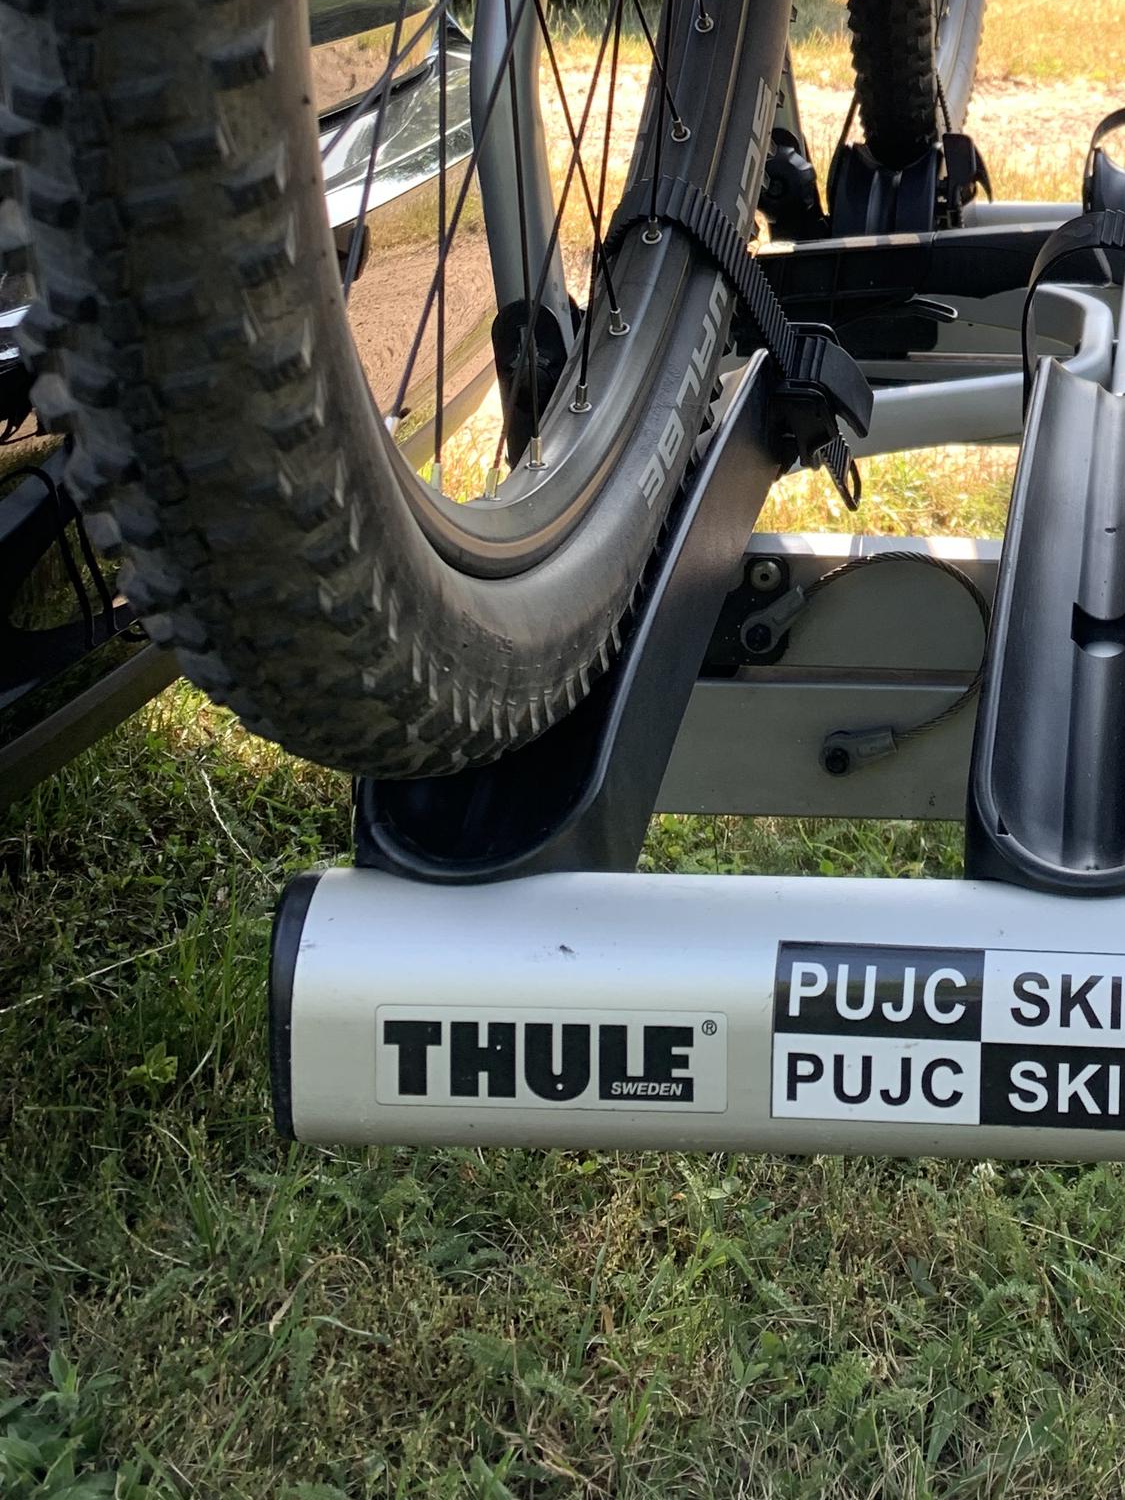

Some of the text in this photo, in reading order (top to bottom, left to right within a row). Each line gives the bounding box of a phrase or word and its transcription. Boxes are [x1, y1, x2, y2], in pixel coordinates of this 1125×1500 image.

[789, 962, 967, 1025] PUJC
[1011, 972, 1122, 1031] SKI
[384, 1020, 694, 1101] THULE
[610, 1081, 683, 1097] SWEDEN
[787, 1053, 964, 1107] PUJC
[1008, 1060, 1121, 1116] SKI
